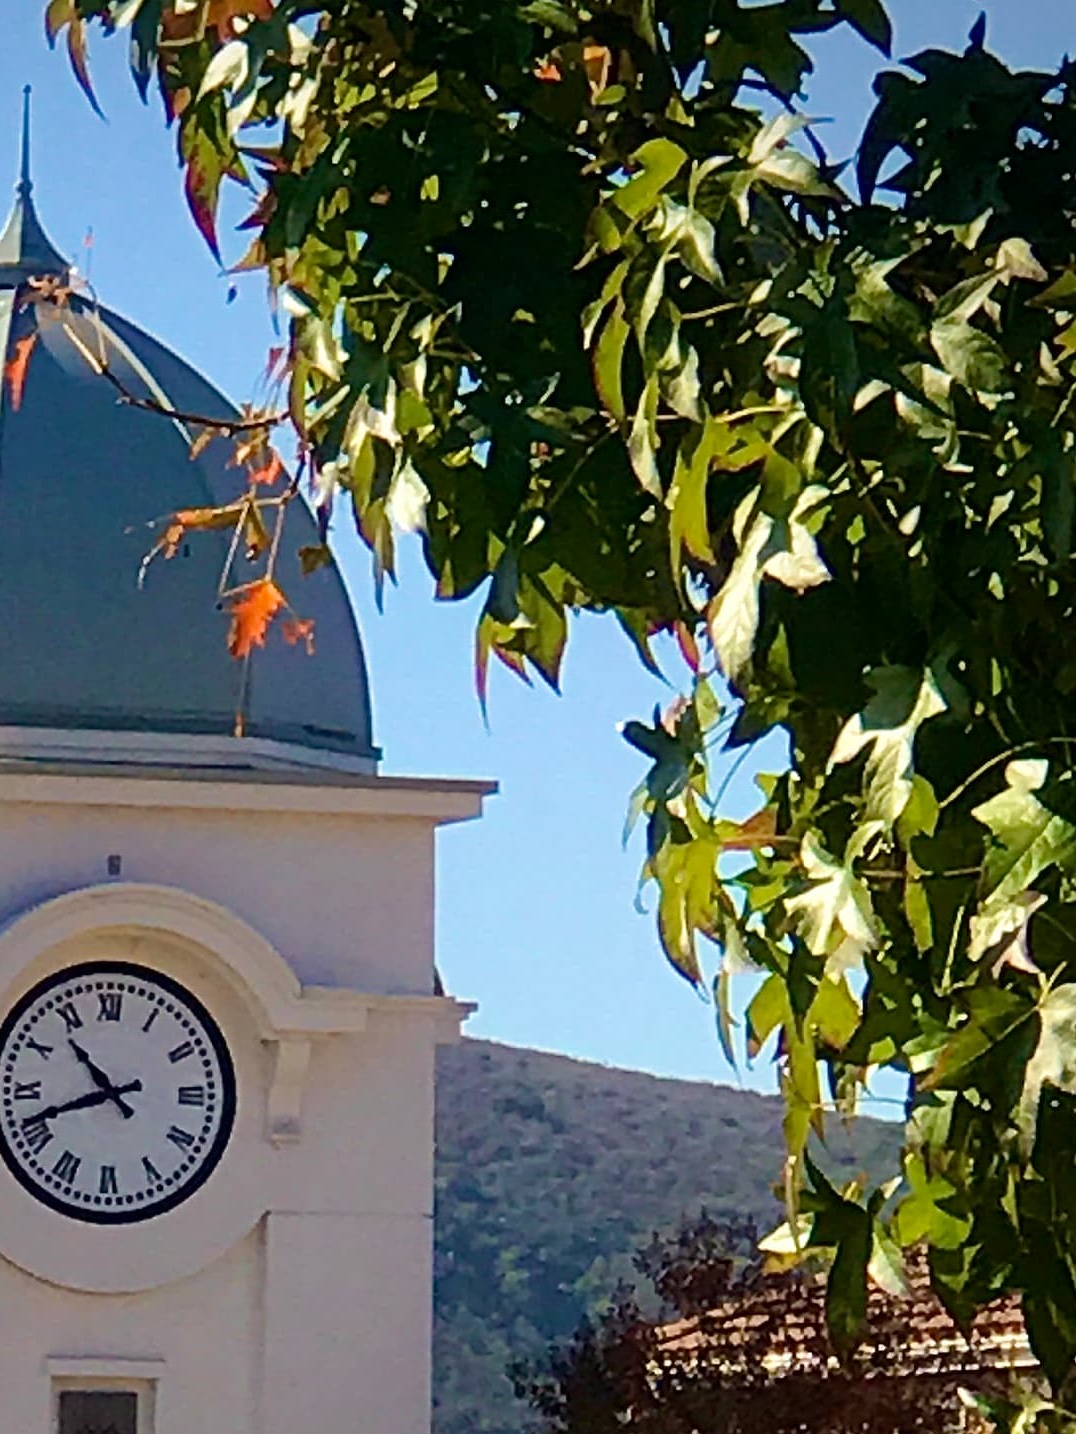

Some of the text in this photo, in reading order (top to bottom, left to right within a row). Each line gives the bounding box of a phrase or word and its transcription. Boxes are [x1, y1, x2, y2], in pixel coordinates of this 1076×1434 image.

[56, 1002, 82, 1033] XI
[97, 993, 122, 1022] XII
[142, 1008, 159, 1032] I
[26, 1037, 53, 1059] X
[168, 1041, 194, 1064] II
[14, 1081, 40, 1100] IX
[179, 1086, 204, 1106] III
[166, 1125, 195, 1152] IV
[53, 1151, 81, 1184] VII
[100, 1165, 117, 1194] VI
[142, 1157, 162, 1183] V
